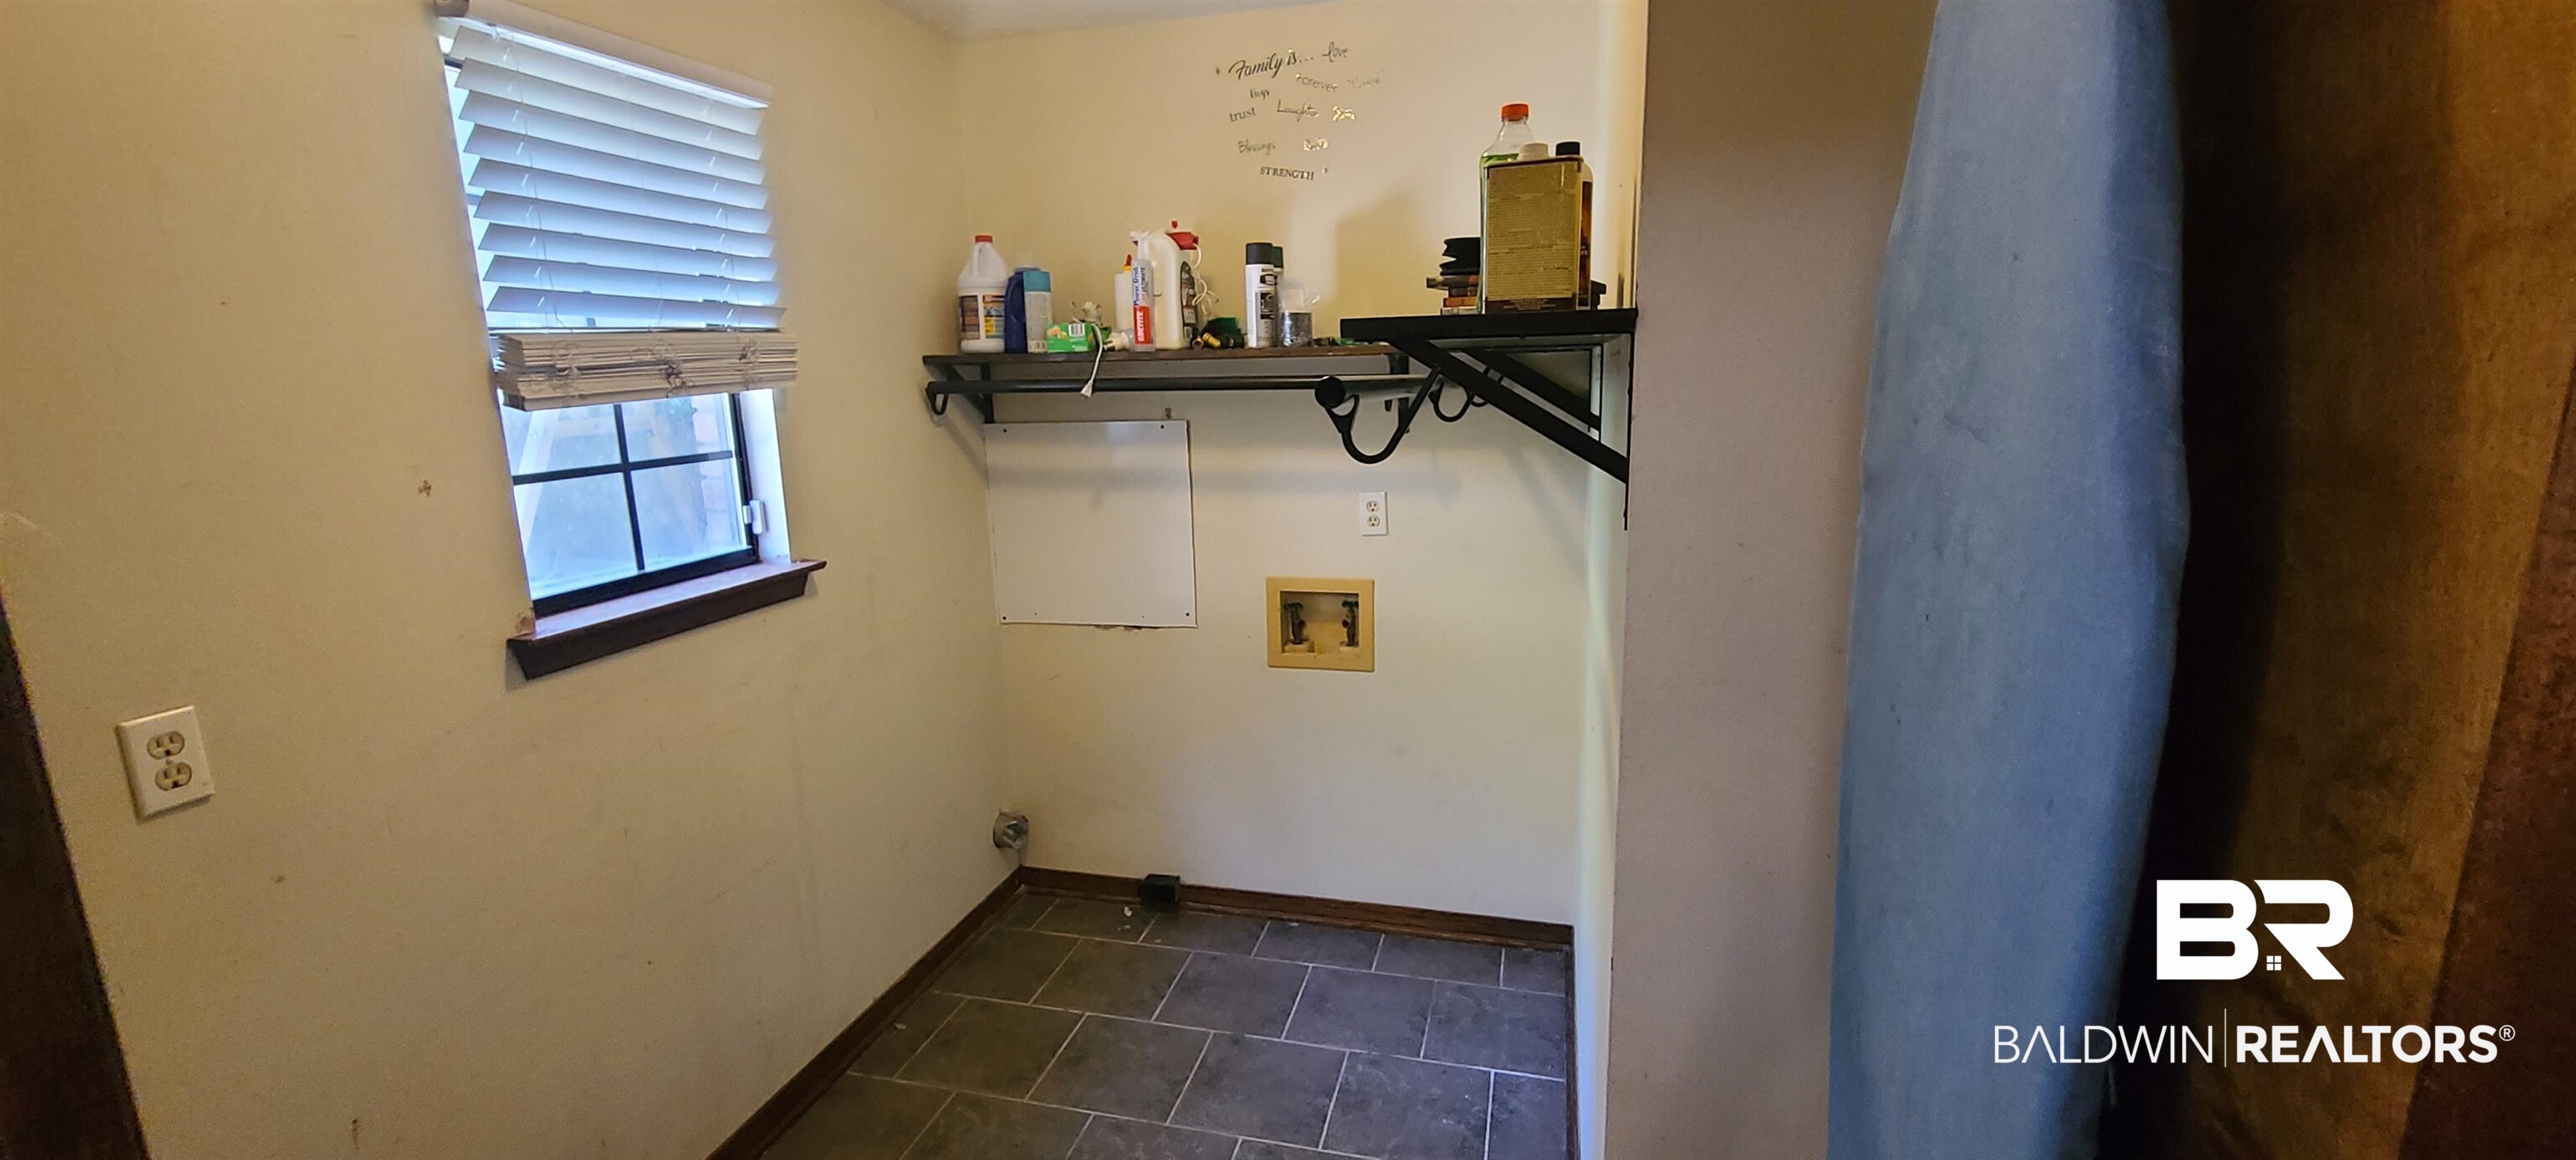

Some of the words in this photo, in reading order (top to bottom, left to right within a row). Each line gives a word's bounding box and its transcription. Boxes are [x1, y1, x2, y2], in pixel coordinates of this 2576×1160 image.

[1322, 41, 1348, 63] love
[1228, 53, 1284, 81] Family
[1296, 73, 1339, 93] Forever
[1229, 107, 1257, 123] trust
[1259, 165, 1315, 180] STRENGTH
